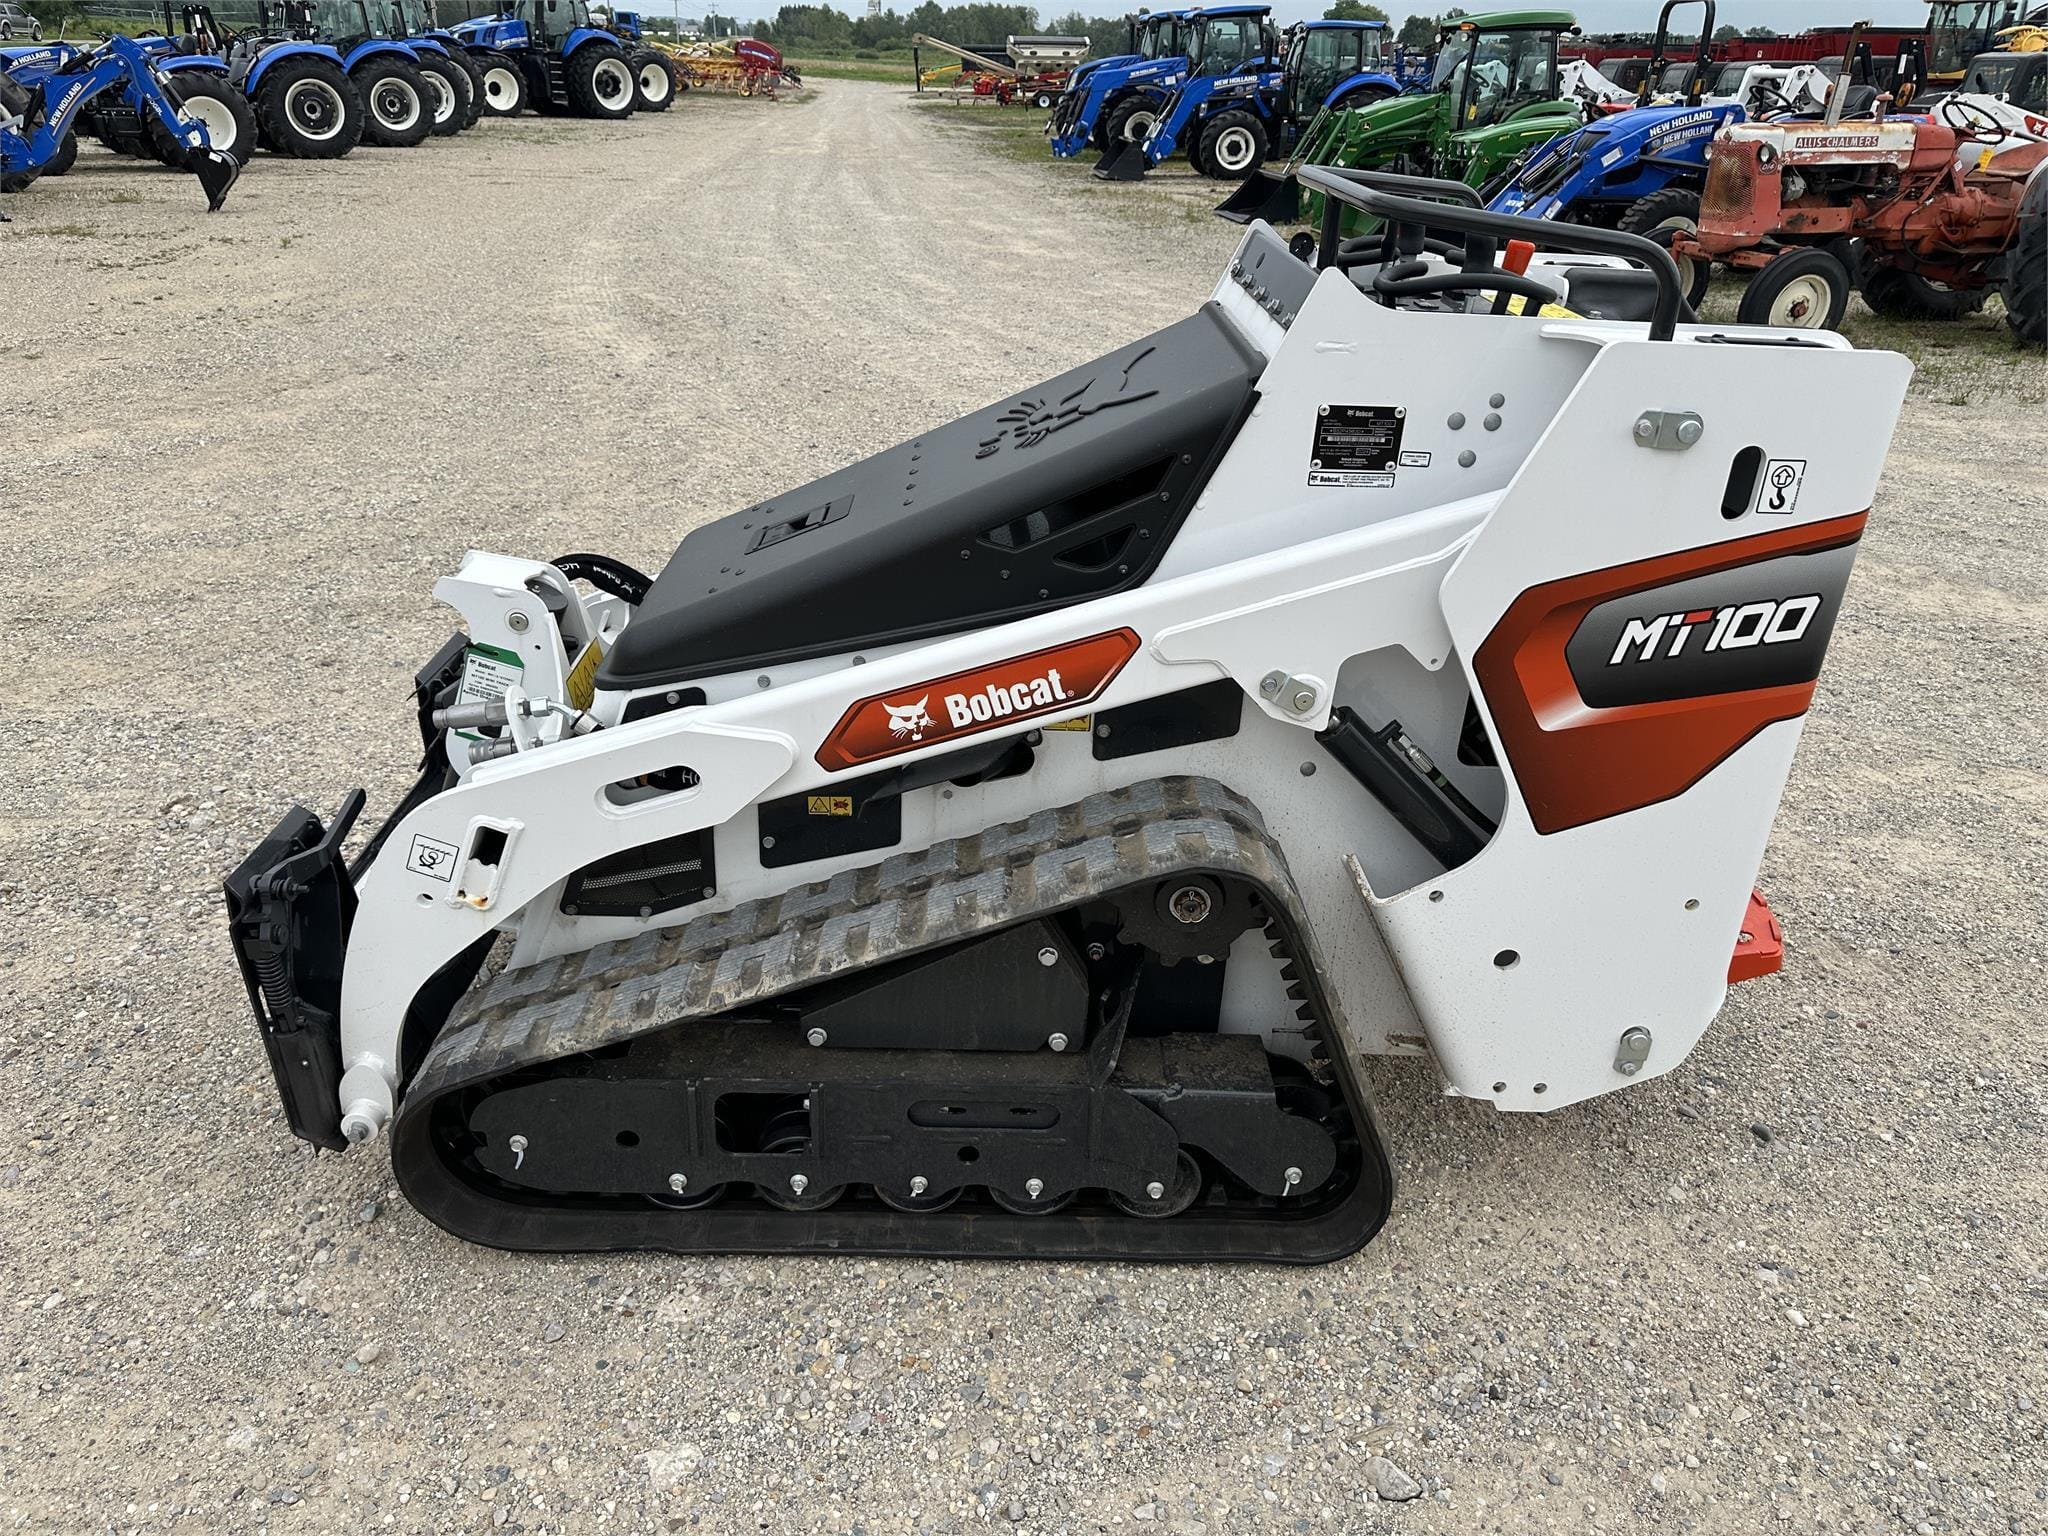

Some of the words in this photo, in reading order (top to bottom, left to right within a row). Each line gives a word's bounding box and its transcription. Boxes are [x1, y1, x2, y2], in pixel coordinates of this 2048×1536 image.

[18, 50, 51, 64] HOLLAND
[1228, 75, 1257, 84] HOLLAND
[49, 107, 62, 127] NEW
[59, 82, 82, 112] HOLLAND
[1649, 122, 1670, 137] NEW
[1671, 110, 1713, 128] HOLLAND
[1663, 132, 1681, 145] NEW
[1796, 136, 1878, 148] ALLIS-CHALMERS
[1320, 475, 1340, 483] Bobcat
[1609, 595, 1821, 665] MT100
[478, 661, 497, 671] Bobcat
[944, 668, 1067, 728] Bobcat
